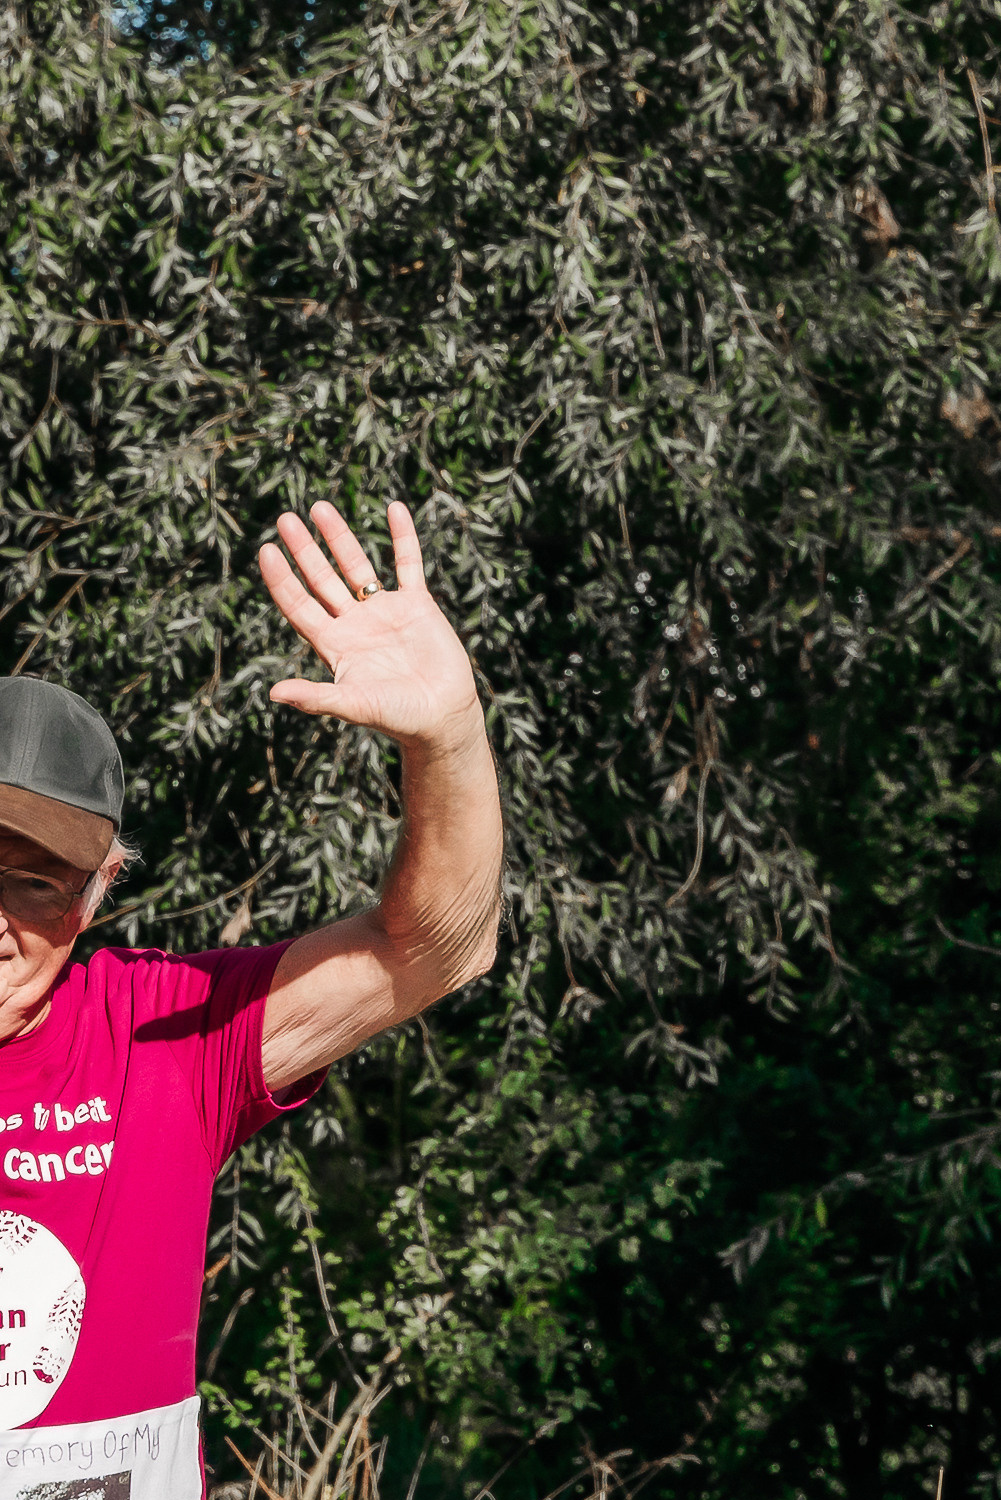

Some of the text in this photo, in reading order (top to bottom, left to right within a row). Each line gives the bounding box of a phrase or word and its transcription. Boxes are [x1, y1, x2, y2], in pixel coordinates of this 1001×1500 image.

[33, 1103, 50, 1131] to
[54, 1096, 112, 1132] beat
[3, 1140, 115, 1182] Cancer
[103, 1430, 130, 1465] Of
[134, 1423, 162, 1461] My
